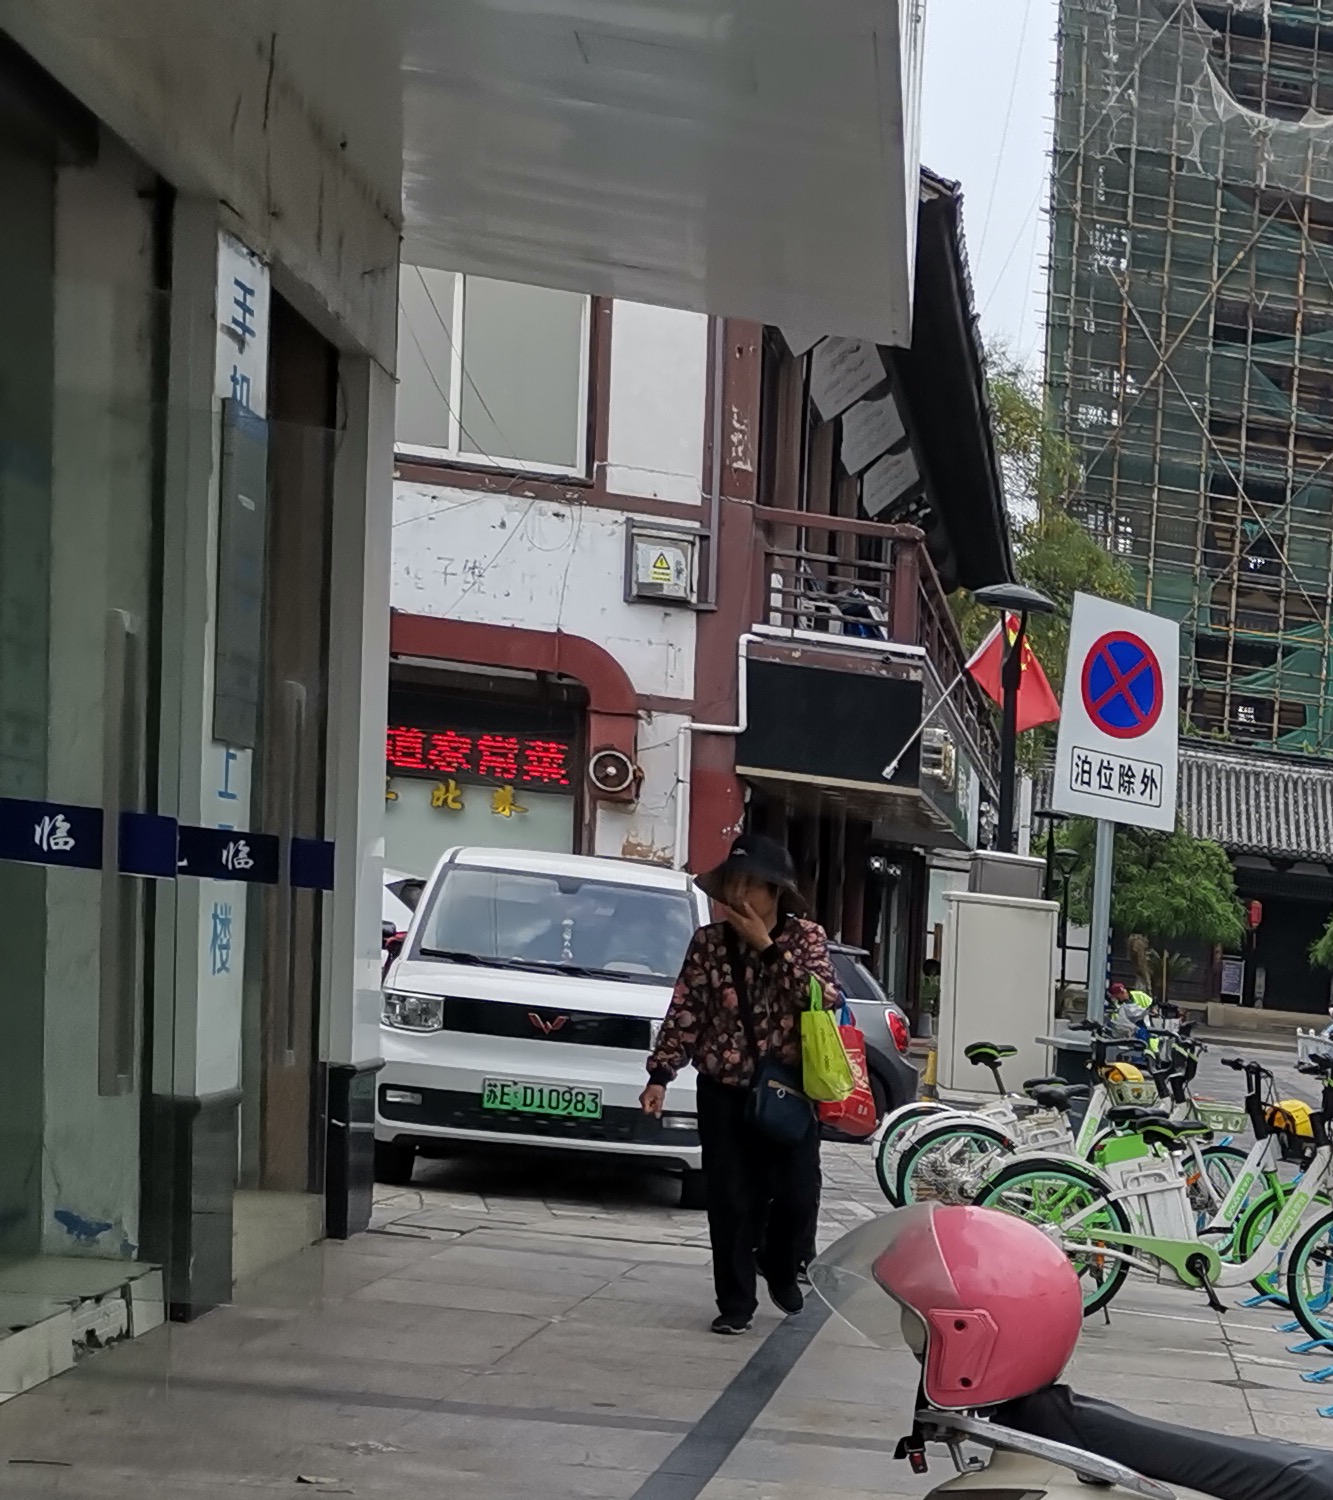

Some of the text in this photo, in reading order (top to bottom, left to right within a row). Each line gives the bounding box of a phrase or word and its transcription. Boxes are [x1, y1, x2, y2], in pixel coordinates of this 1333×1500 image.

[1074, 754, 1158, 802] 泊位除外
[34, 814, 76, 853] 临
[221, 839, 255, 871] 临
